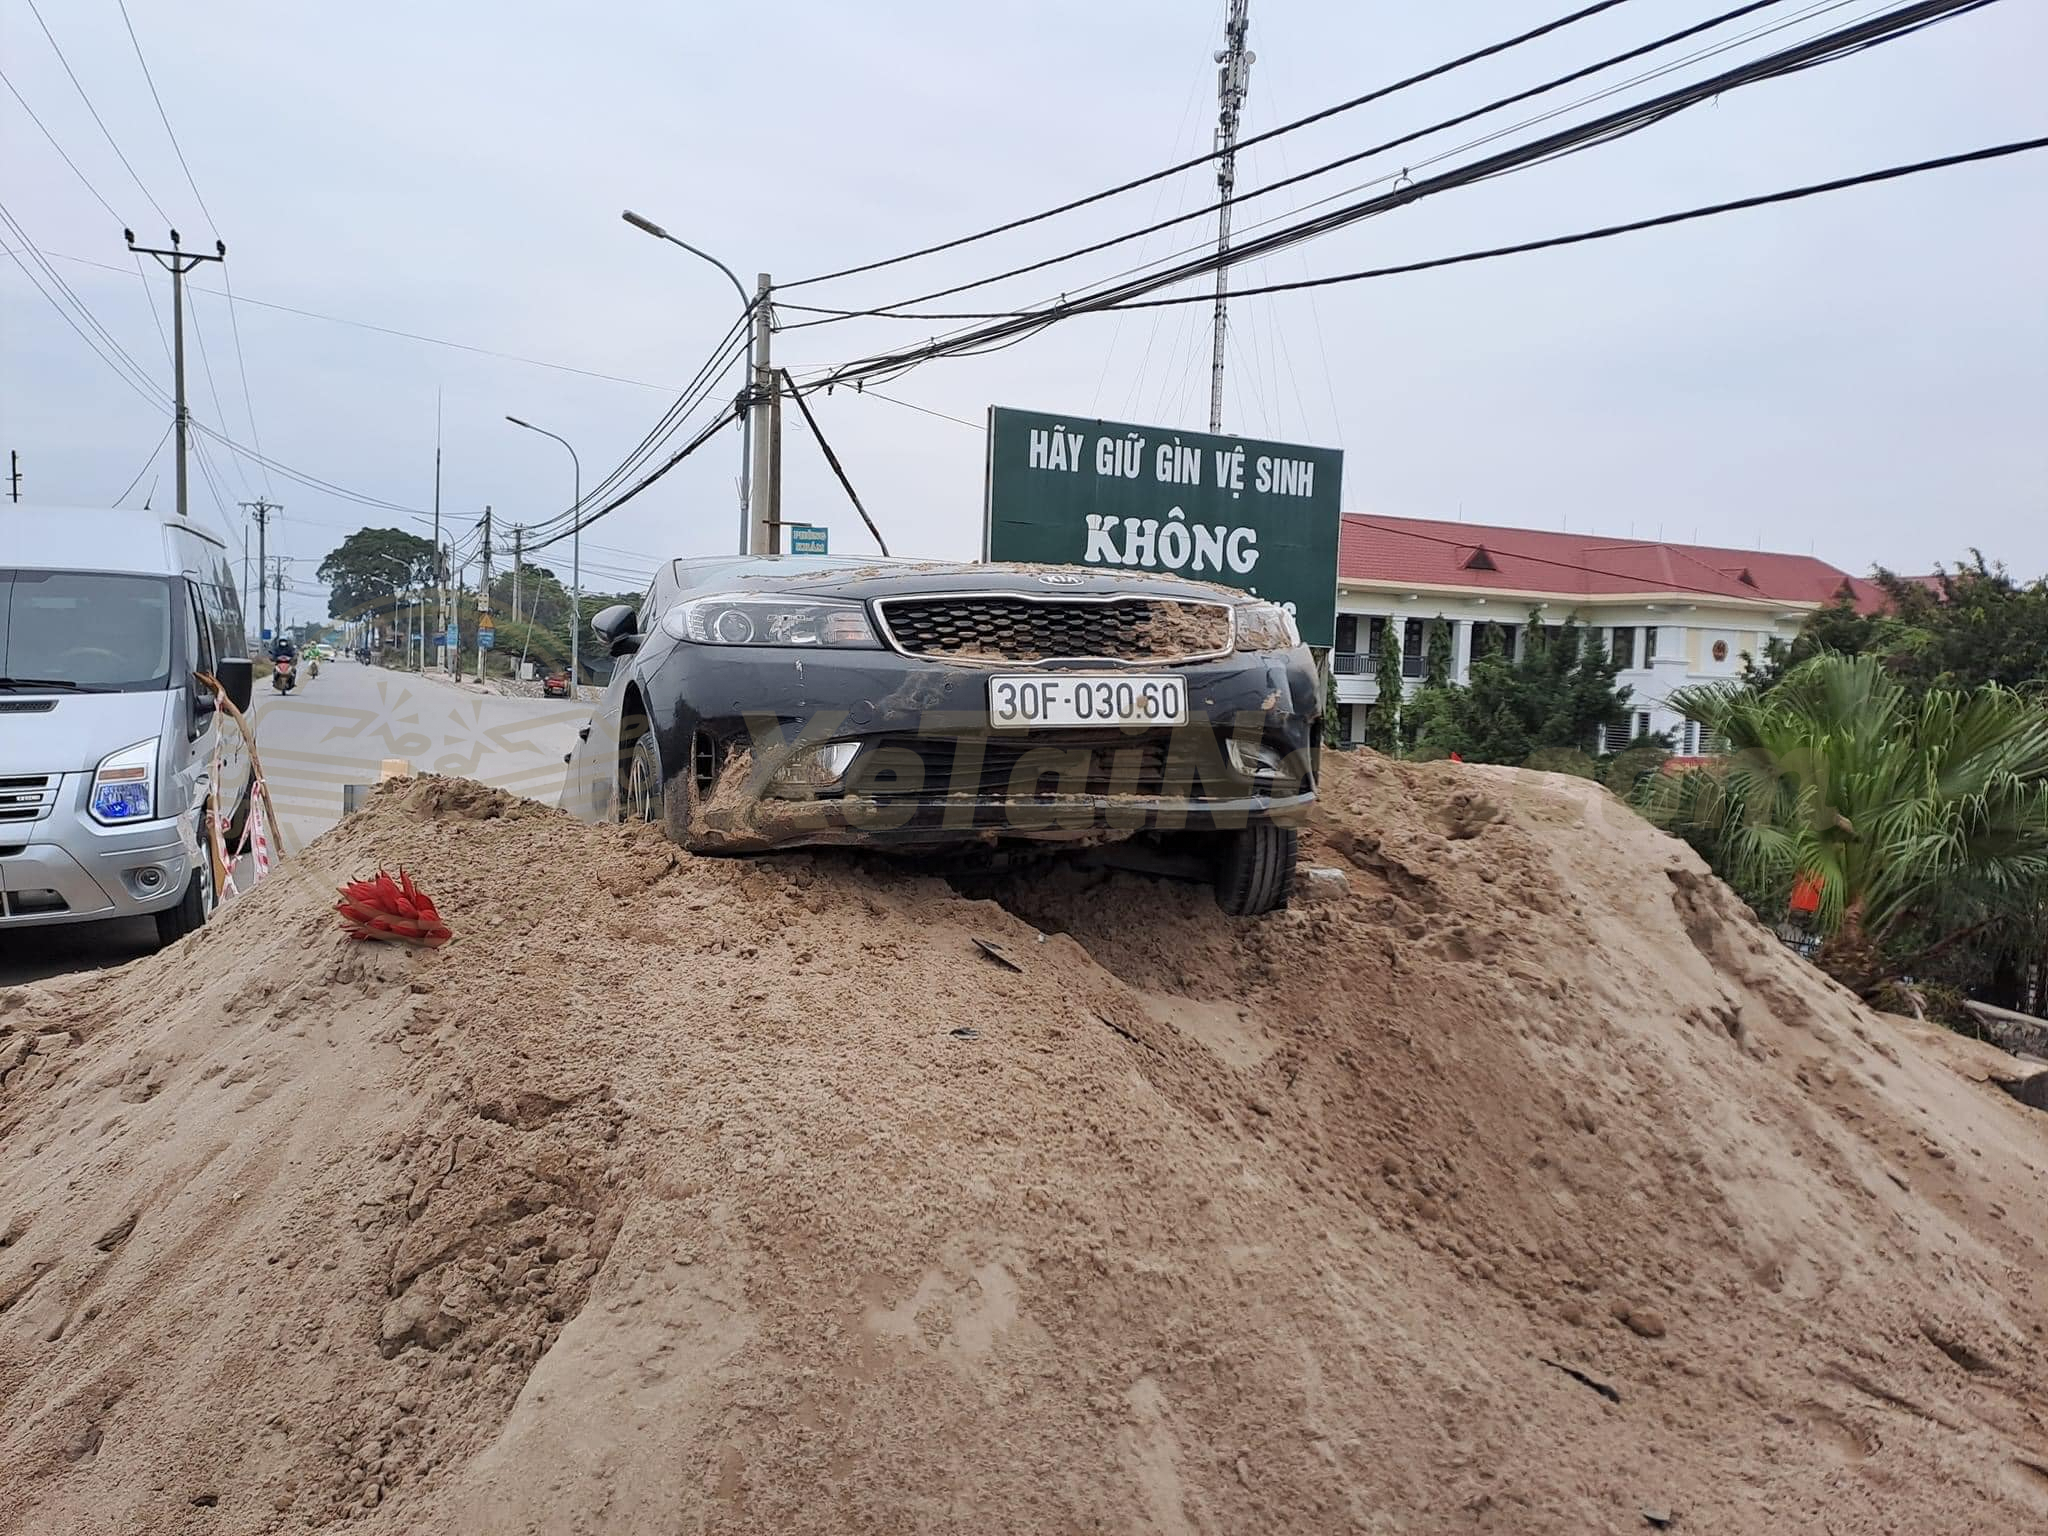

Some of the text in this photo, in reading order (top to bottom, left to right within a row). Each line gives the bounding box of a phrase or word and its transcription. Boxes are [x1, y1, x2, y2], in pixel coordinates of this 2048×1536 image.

[1029, 425, 1314, 499] HÃY GIỮ GÌN VỆ SINH
[1084, 506, 1260, 573] KHÔNG
[997, 682, 1179, 720] 30F-030.60
